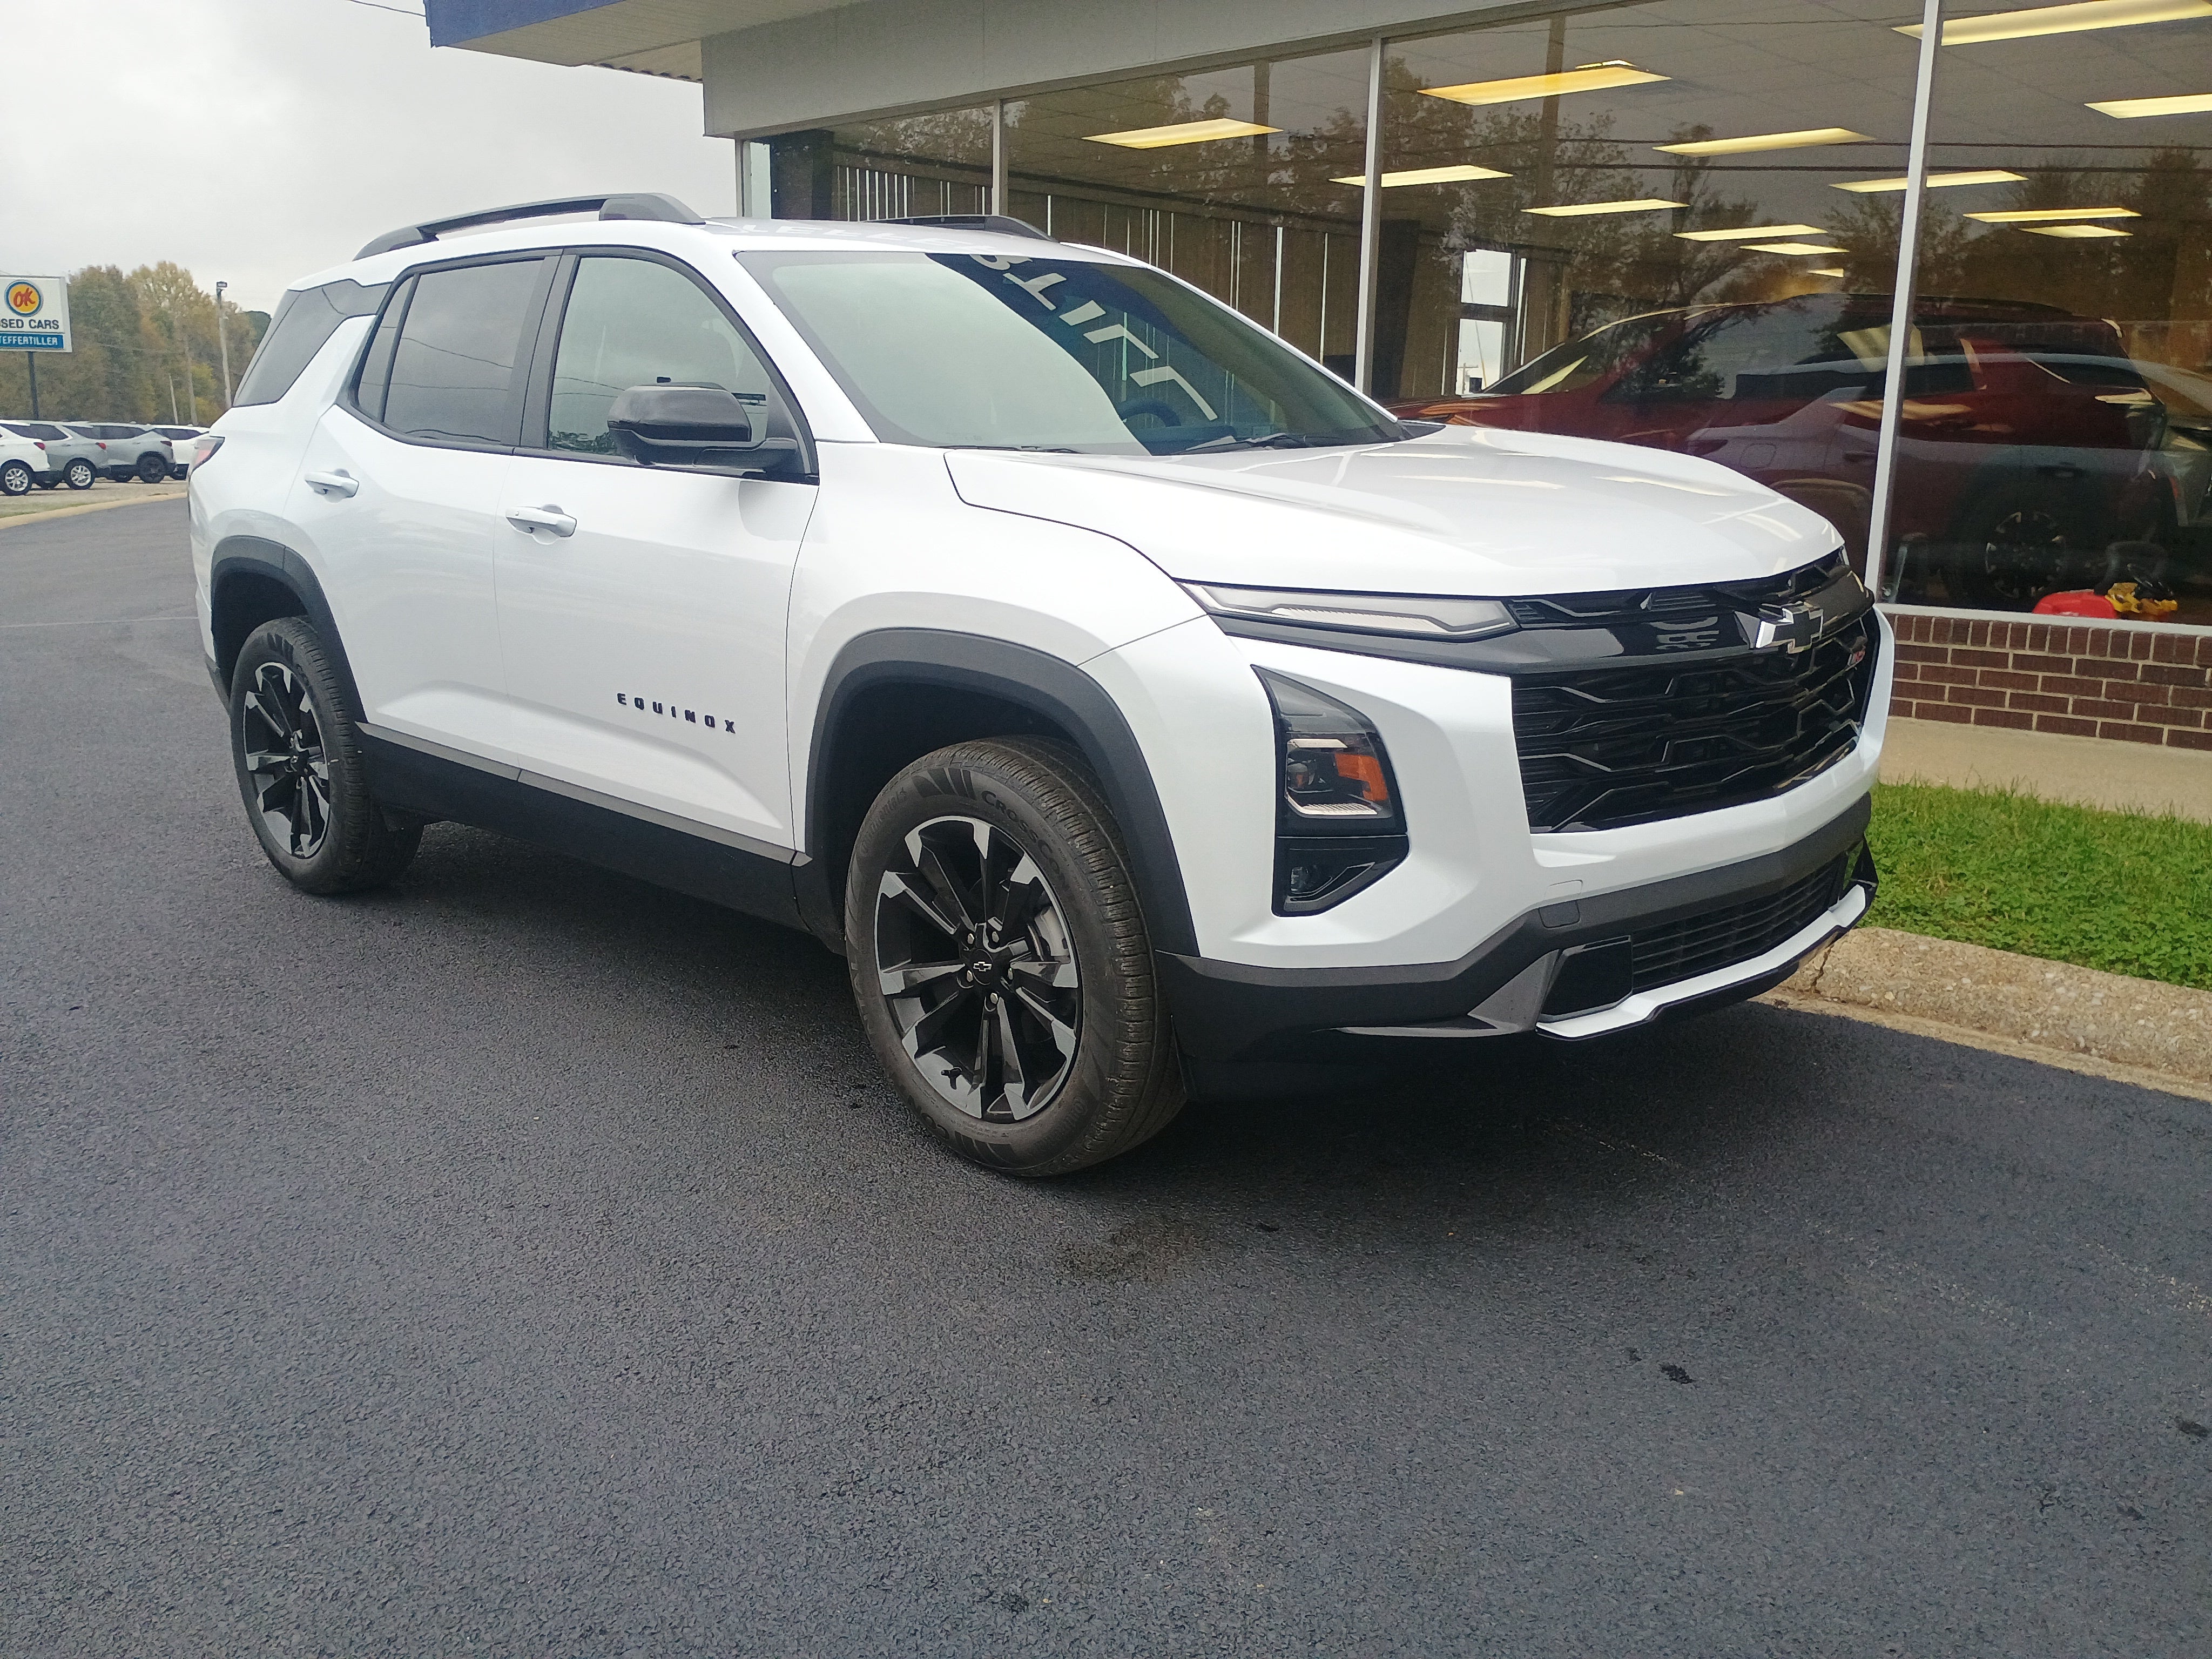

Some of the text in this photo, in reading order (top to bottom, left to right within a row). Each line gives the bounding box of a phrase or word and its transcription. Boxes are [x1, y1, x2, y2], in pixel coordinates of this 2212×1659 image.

[14, 287, 36, 307] OK
[0, 319, 59, 329] SED CARS
[617, 693, 736, 734] EQUINOX
